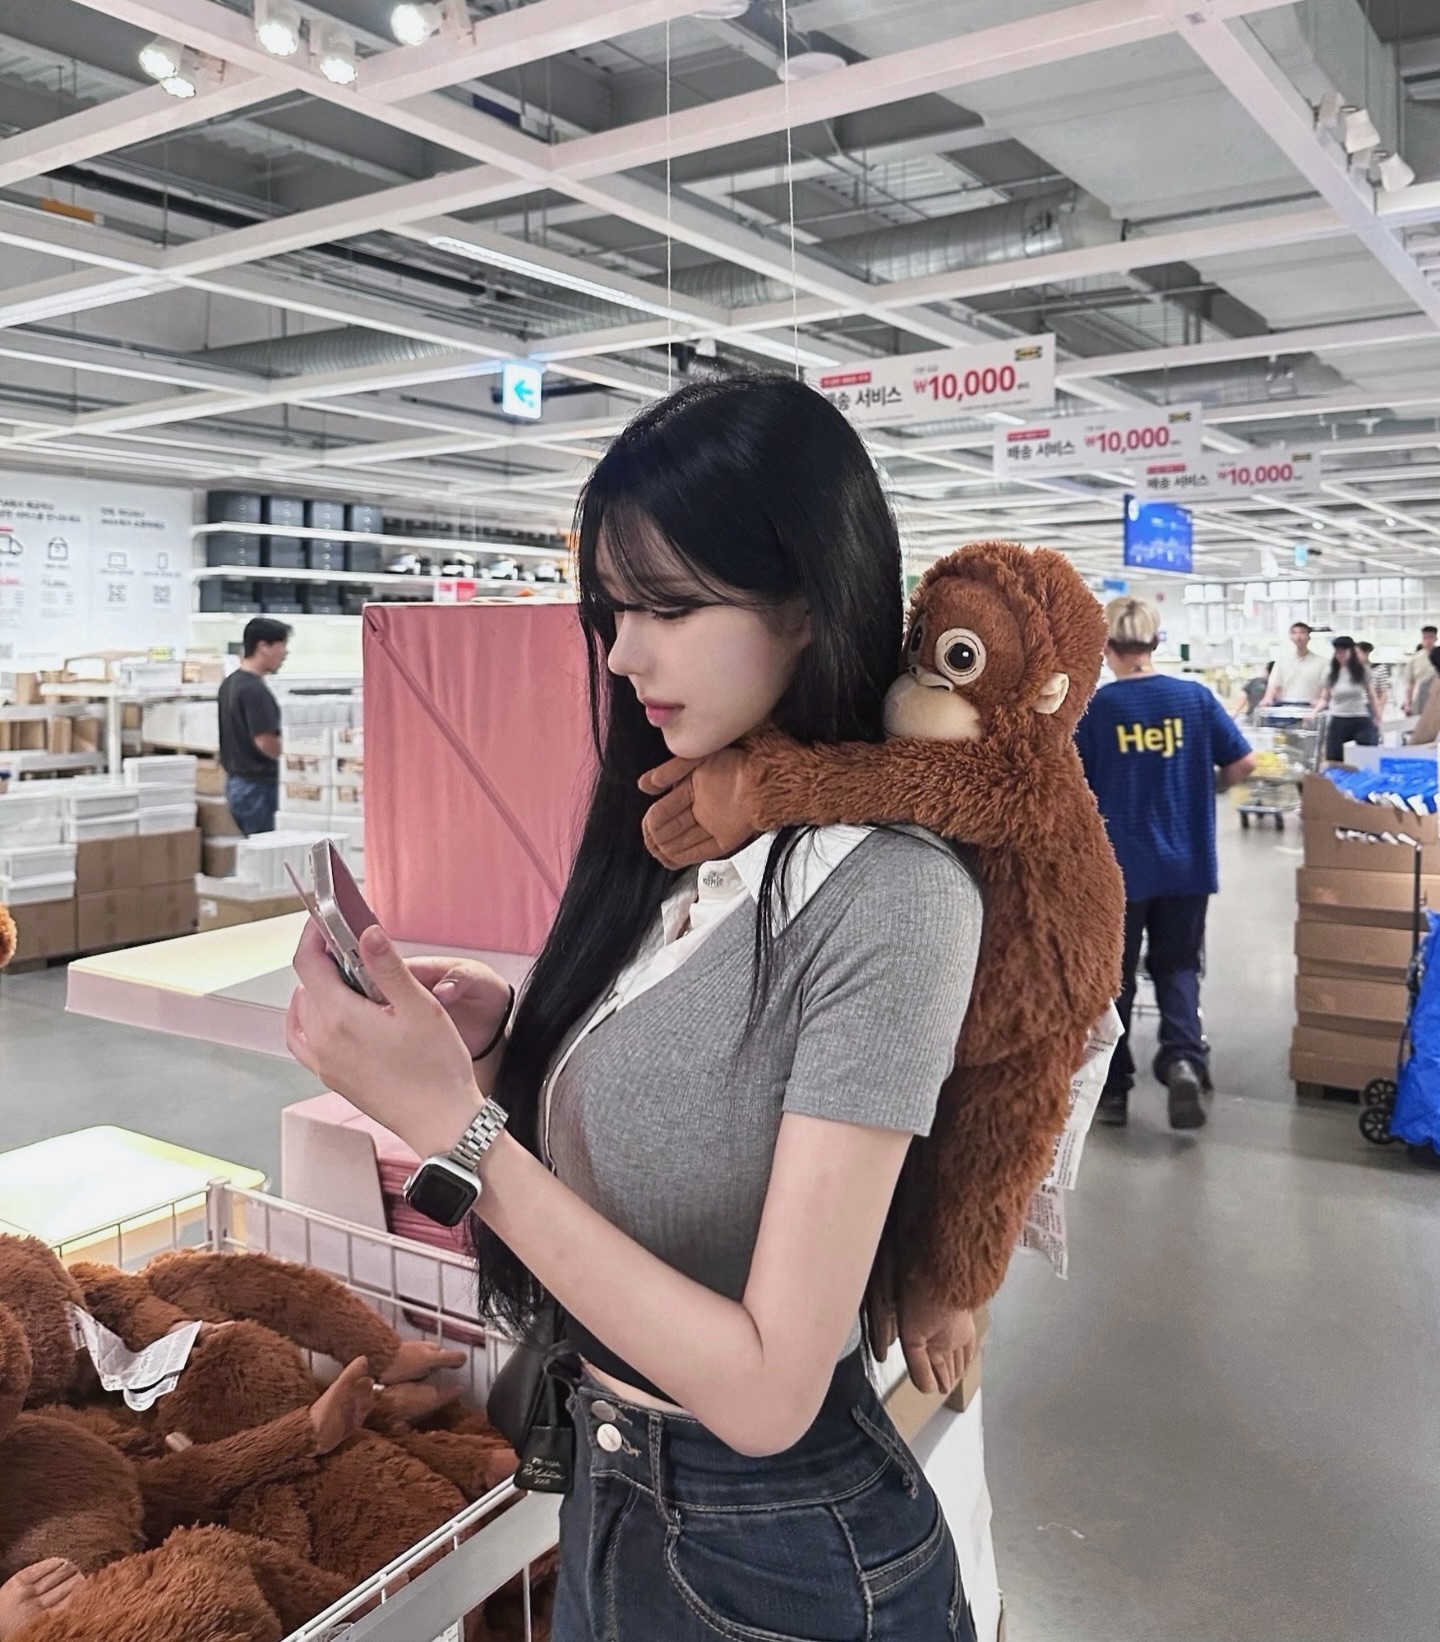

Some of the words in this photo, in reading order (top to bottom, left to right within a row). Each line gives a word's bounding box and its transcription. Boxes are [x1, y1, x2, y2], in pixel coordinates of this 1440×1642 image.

[855, 385, 902, 408] 서비스
[913, 365, 1015, 402] ₩10,000
[1007, 445, 1032, 460] 배송
[1035, 440, 1075, 458] 서비스
[1084, 426, 1169, 454] ₩10,000
[1116, 718, 1184, 758] Hej!
